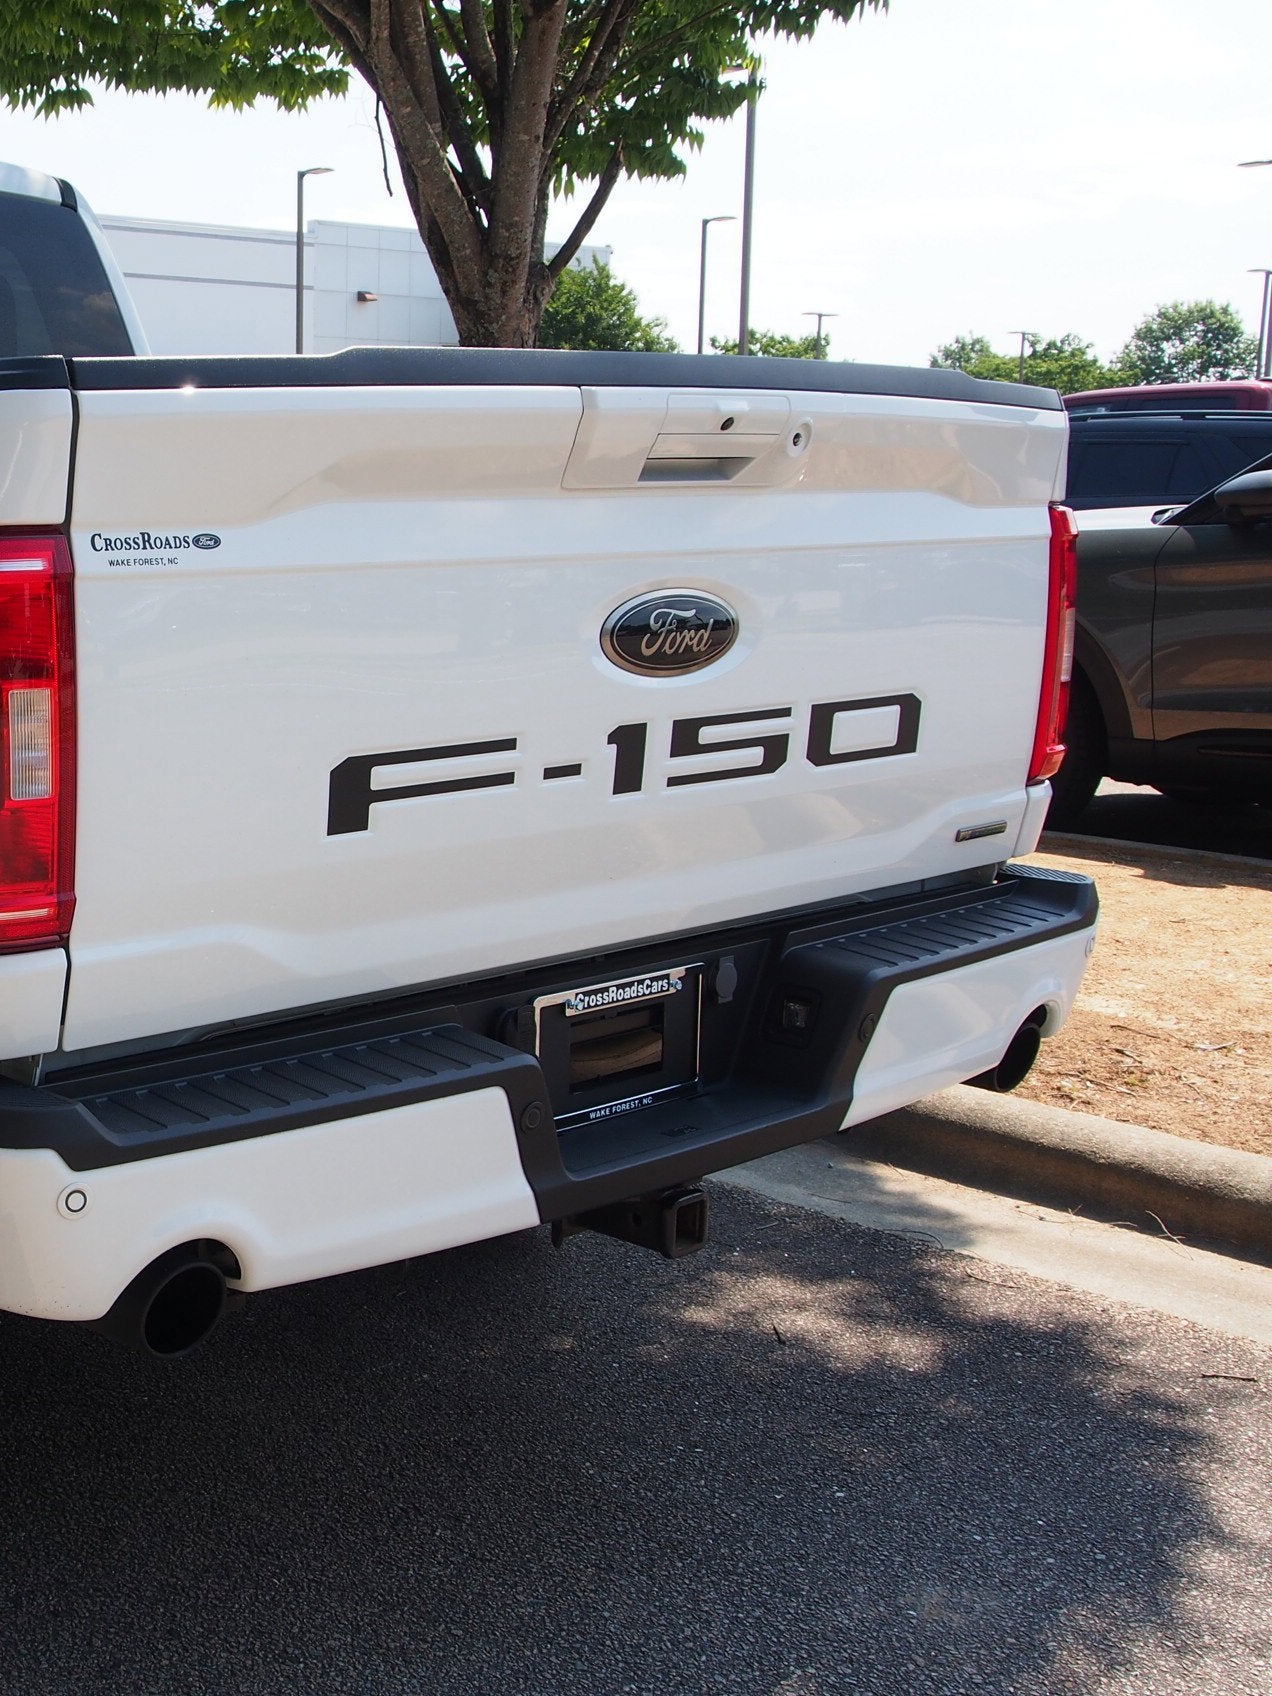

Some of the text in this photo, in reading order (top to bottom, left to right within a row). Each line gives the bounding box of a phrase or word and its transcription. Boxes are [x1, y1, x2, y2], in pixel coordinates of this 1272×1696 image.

[108, 557, 179, 567] WAKE FOREST, NC
[640, 608, 714, 657] Ford
[327, 692, 922, 836] F-150
[575, 978, 669, 1010] CrossRoadsCars
[589, 1096, 653, 1120] WAKE FOREST, NC
